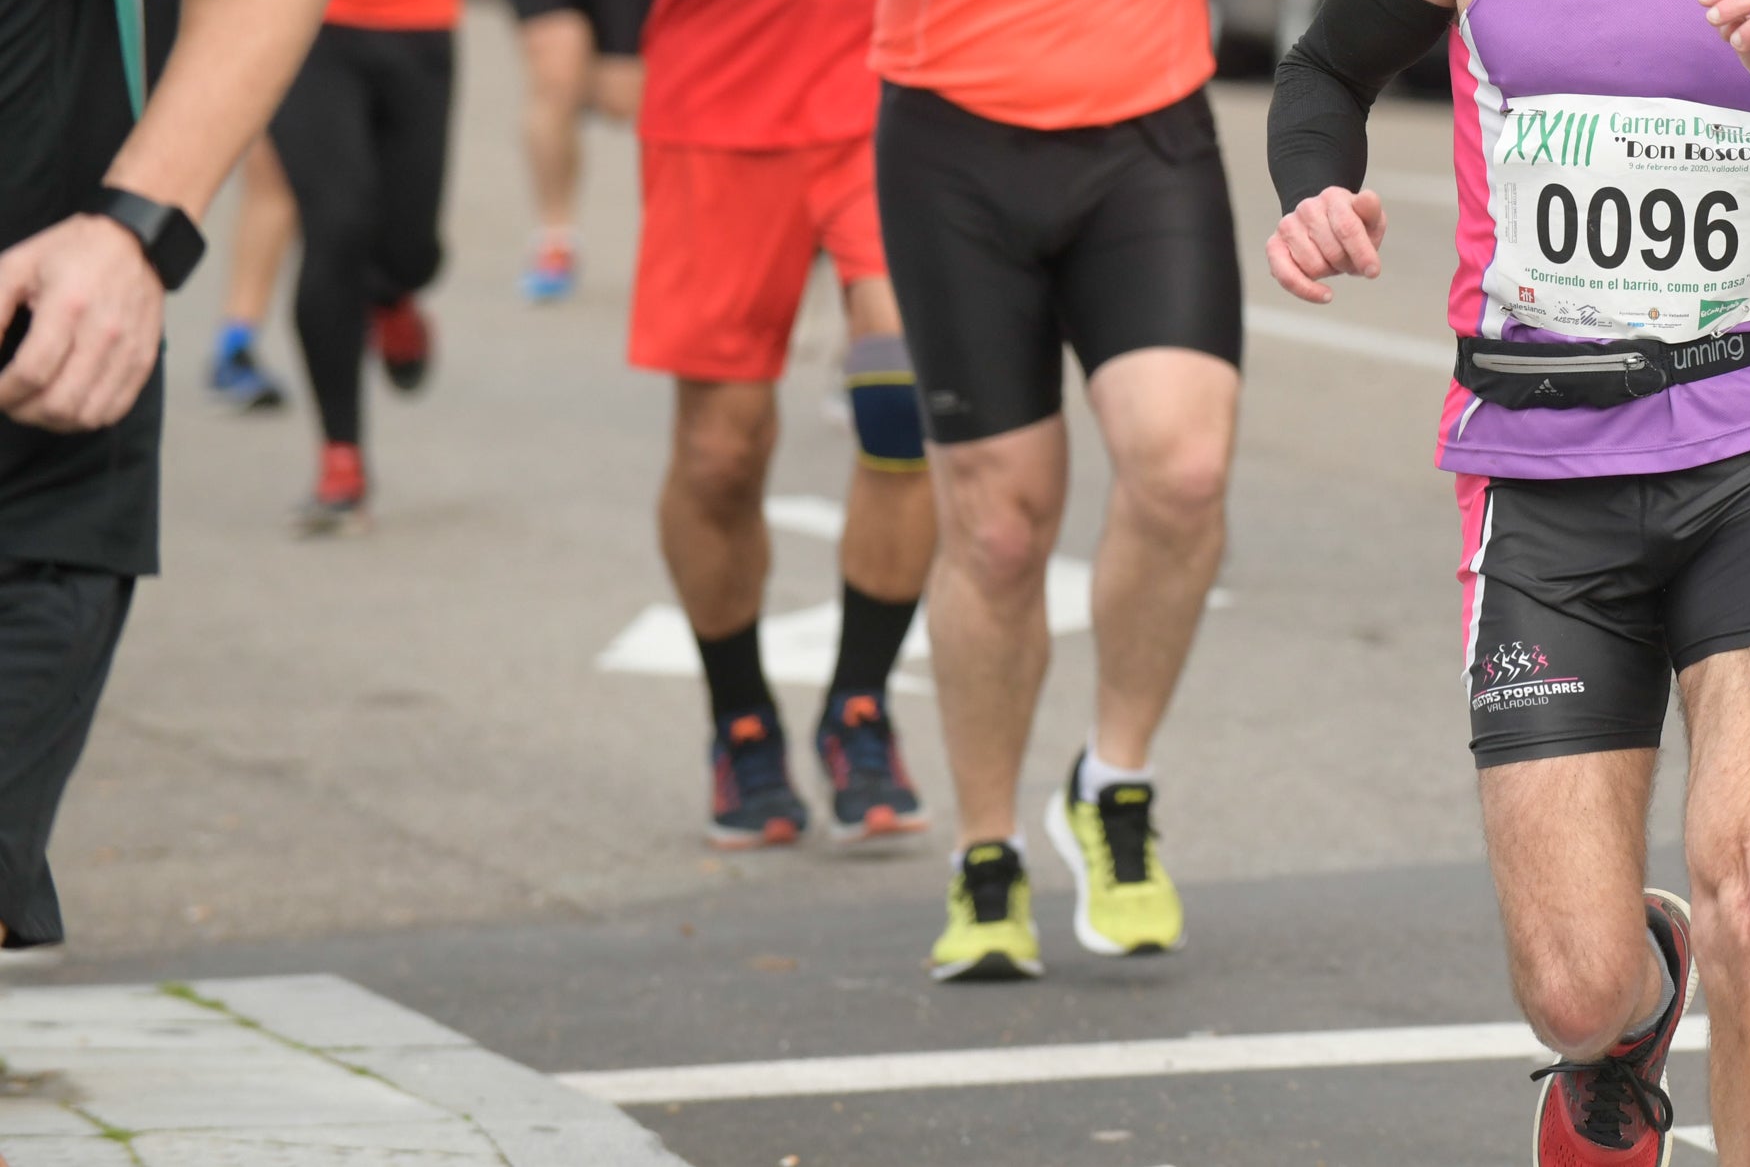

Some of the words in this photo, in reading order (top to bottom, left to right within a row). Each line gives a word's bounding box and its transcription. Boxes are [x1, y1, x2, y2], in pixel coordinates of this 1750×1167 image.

[1610, 112, 1686, 136] Carrera
[1503, 110, 1600, 167] XXIII
[1628, 162, 1633, 170] 9
[1647, 163, 1678, 171] febrero
[1679, 164, 1688, 172] de
[1690, 164, 1710, 173] 2020,
[1712, 165, 1749, 173] Valladolid
[1537, 183, 1739, 272] 0096
[1525, 267, 1585, 288] “Corriendo
[1589, 279, 1603, 289] en
[1608, 278, 1618, 290] el
[1623, 278, 1662, 293] barrio,
[1667, 282, 1699, 293] como
[1703, 282, 1717, 292] en
[1671, 333, 1745, 370] unning
[1503, 682, 1585, 700] POPULARES
[1487, 696, 1549, 713] VALLADOLID
